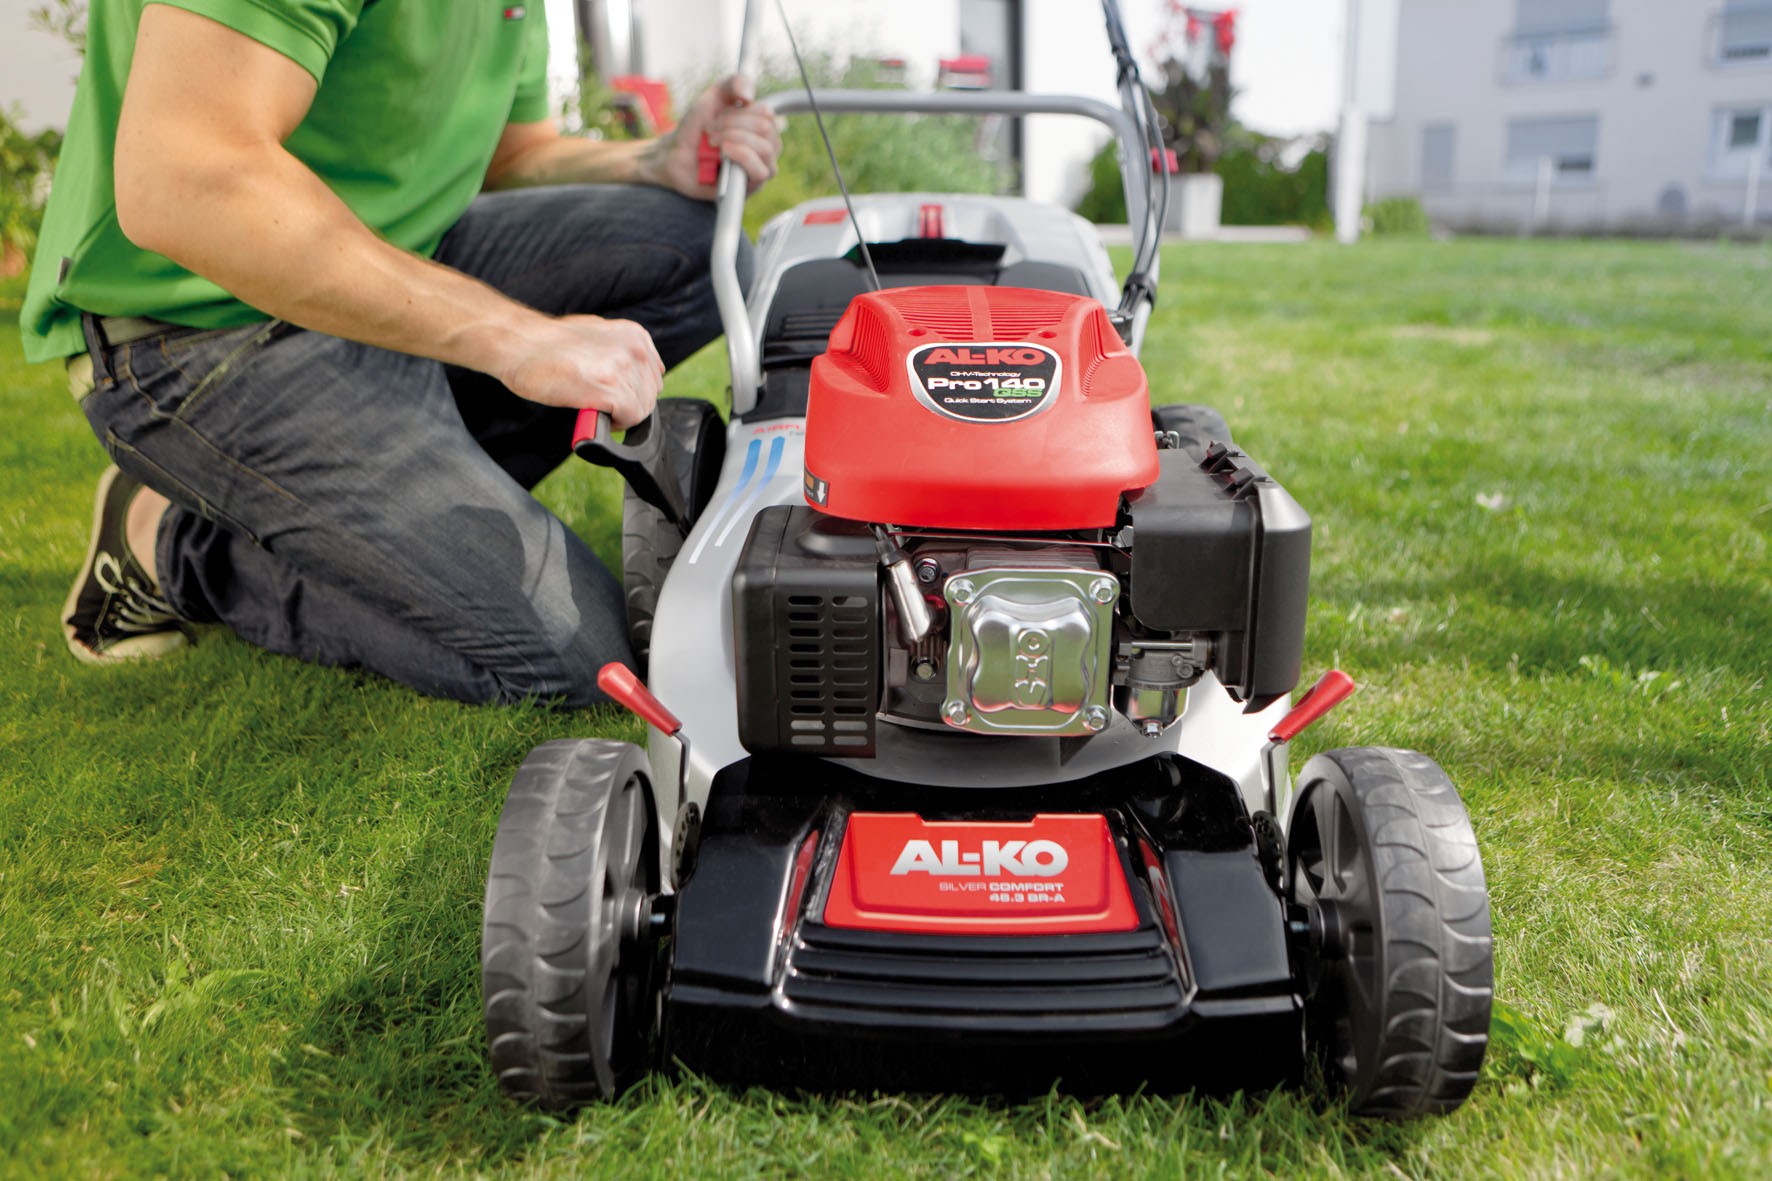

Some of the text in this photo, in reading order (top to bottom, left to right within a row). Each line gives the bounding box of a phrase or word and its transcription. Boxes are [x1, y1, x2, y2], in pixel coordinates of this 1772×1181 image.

[924, 348, 1046, 366] AL-KO
[927, 378, 1046, 390] Pro 140
[993, 388, 1043, 397] QSS
[997, 397, 1032, 406] System
[890, 839, 1069, 877] AL-KO
[939, 882, 1064, 892] SILVER COMFORT
